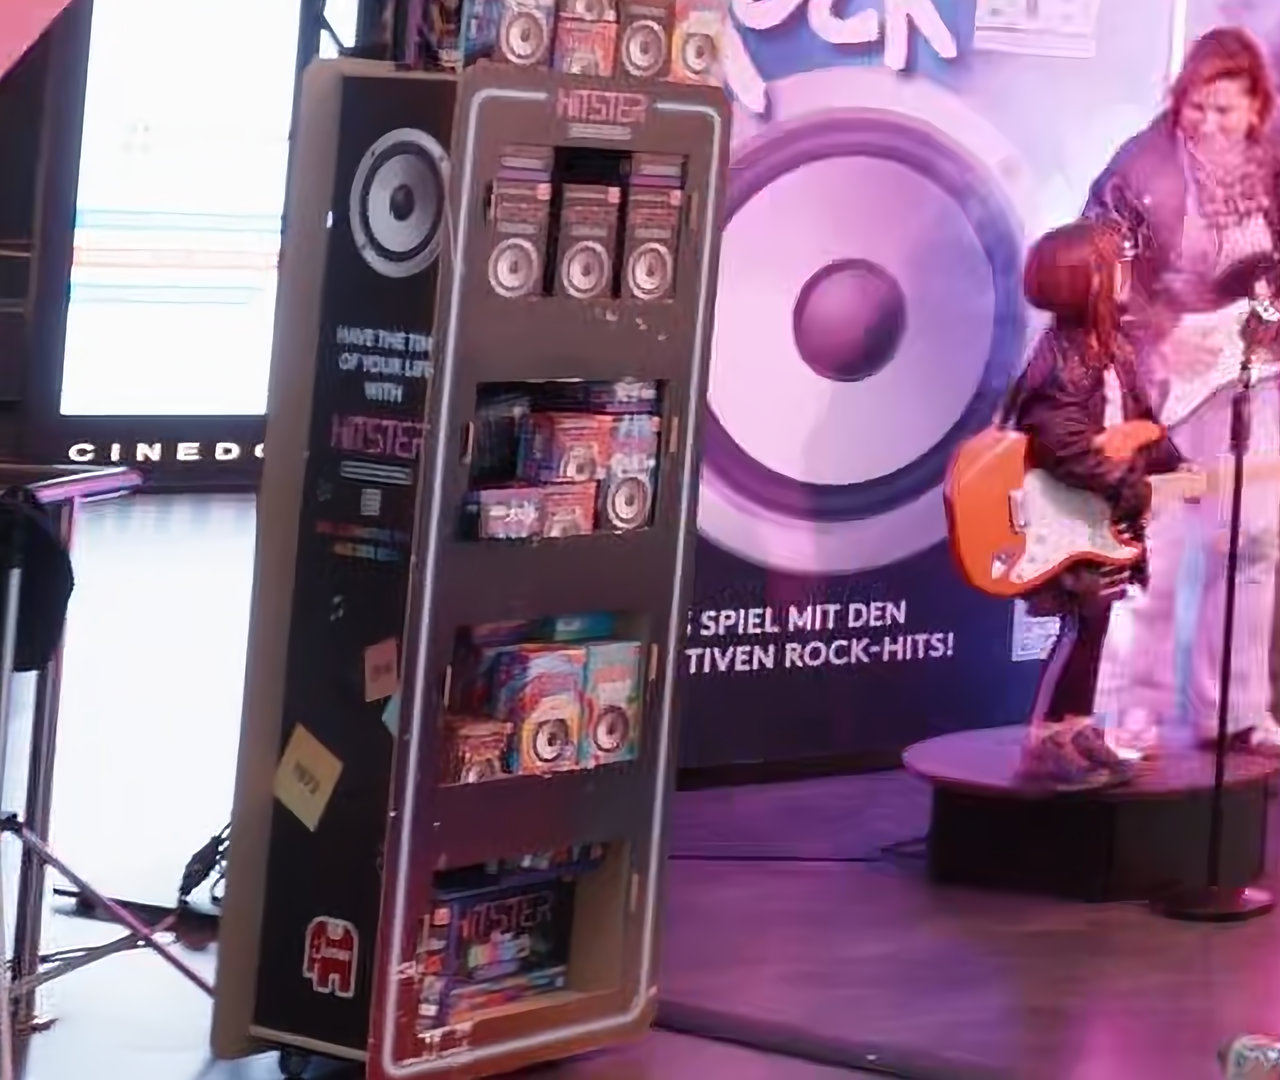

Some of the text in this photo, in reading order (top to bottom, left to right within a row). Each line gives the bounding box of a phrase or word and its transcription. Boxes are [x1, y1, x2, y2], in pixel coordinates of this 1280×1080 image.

[557, 88, 647, 124] HITSTER
[364, 381, 403, 403] WITH
[699, 607, 780, 637] SPIEL
[788, 602, 841, 632] MIT
[848, 599, 906, 629] DEN
[684, 632, 955, 674] TIVEN ROCK-HITS!
